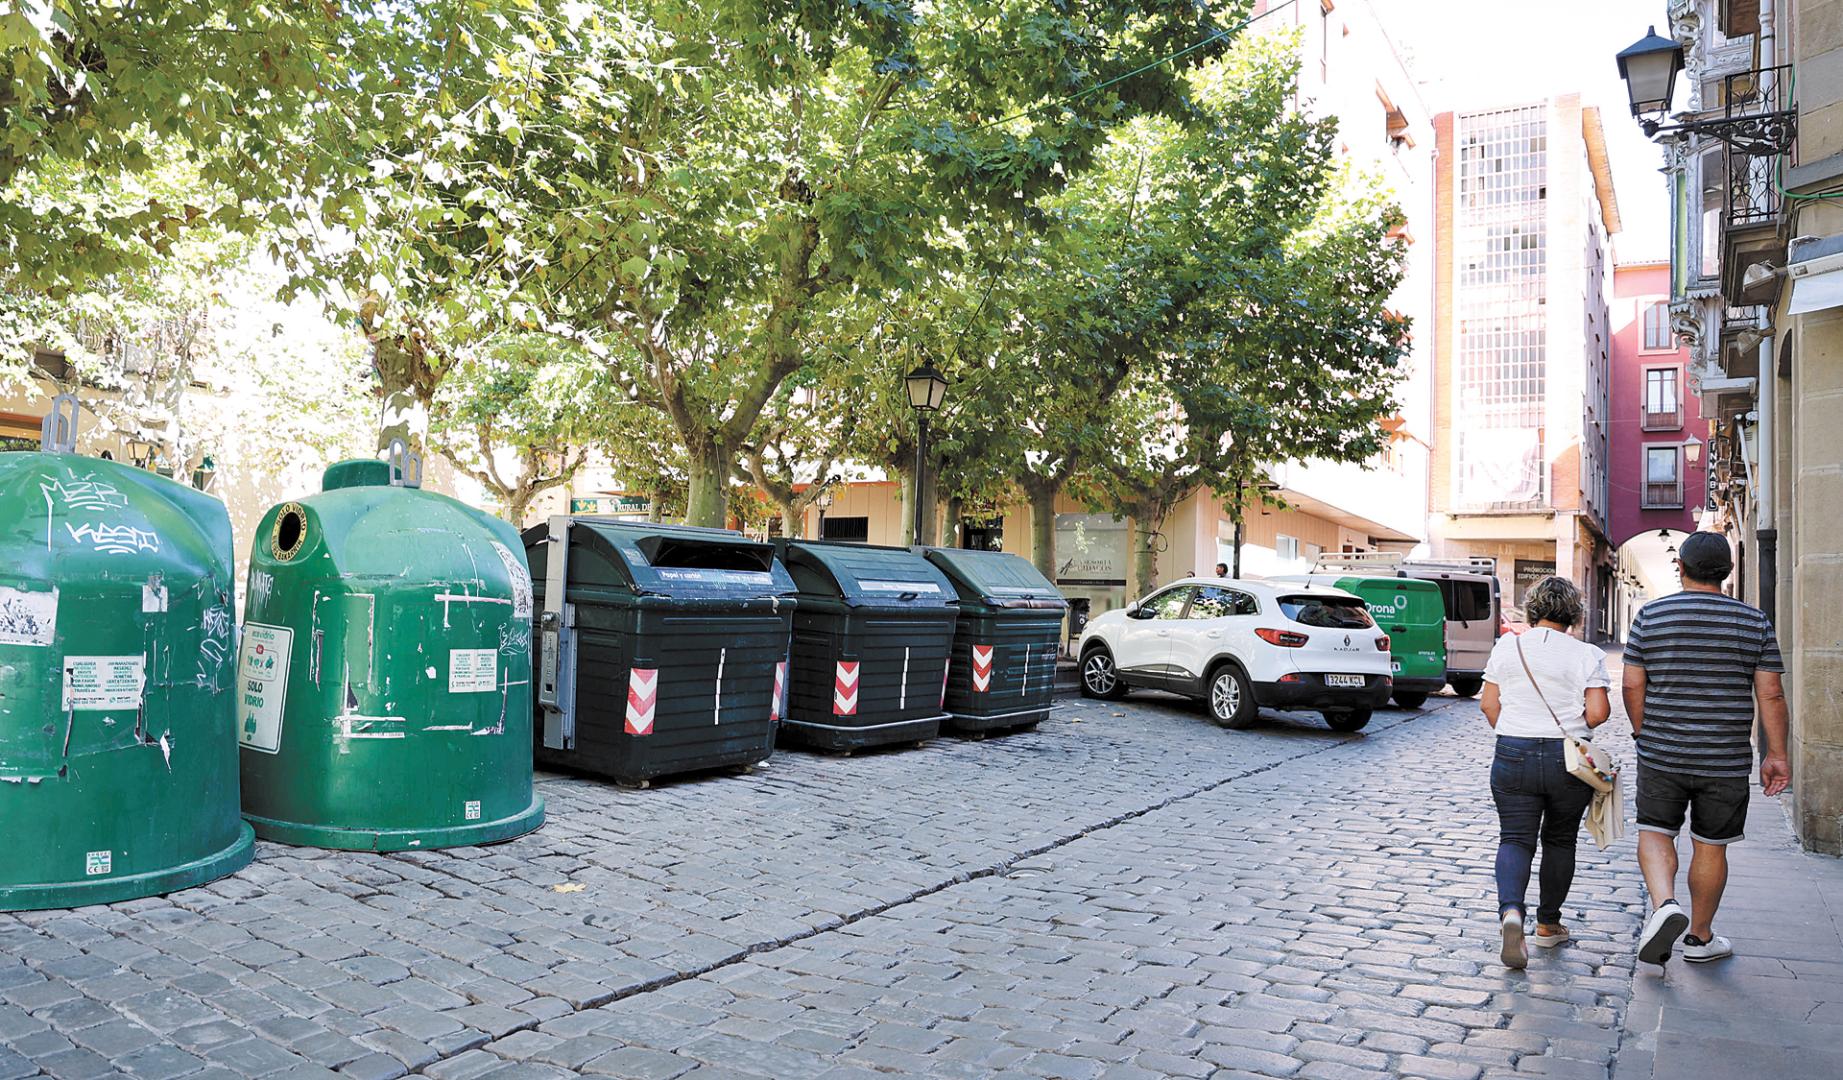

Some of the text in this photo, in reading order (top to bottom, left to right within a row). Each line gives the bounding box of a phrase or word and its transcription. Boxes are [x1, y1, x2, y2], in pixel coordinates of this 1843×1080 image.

[618, 503, 640, 512] RURAL
[661, 571, 679, 579] Papel
[1365, 602, 1395, 614] Orona
[1330, 675, 1348, 685] 3244
[247, 680, 263, 693] SOLO
[244, 693, 264, 708] VIDRIO
